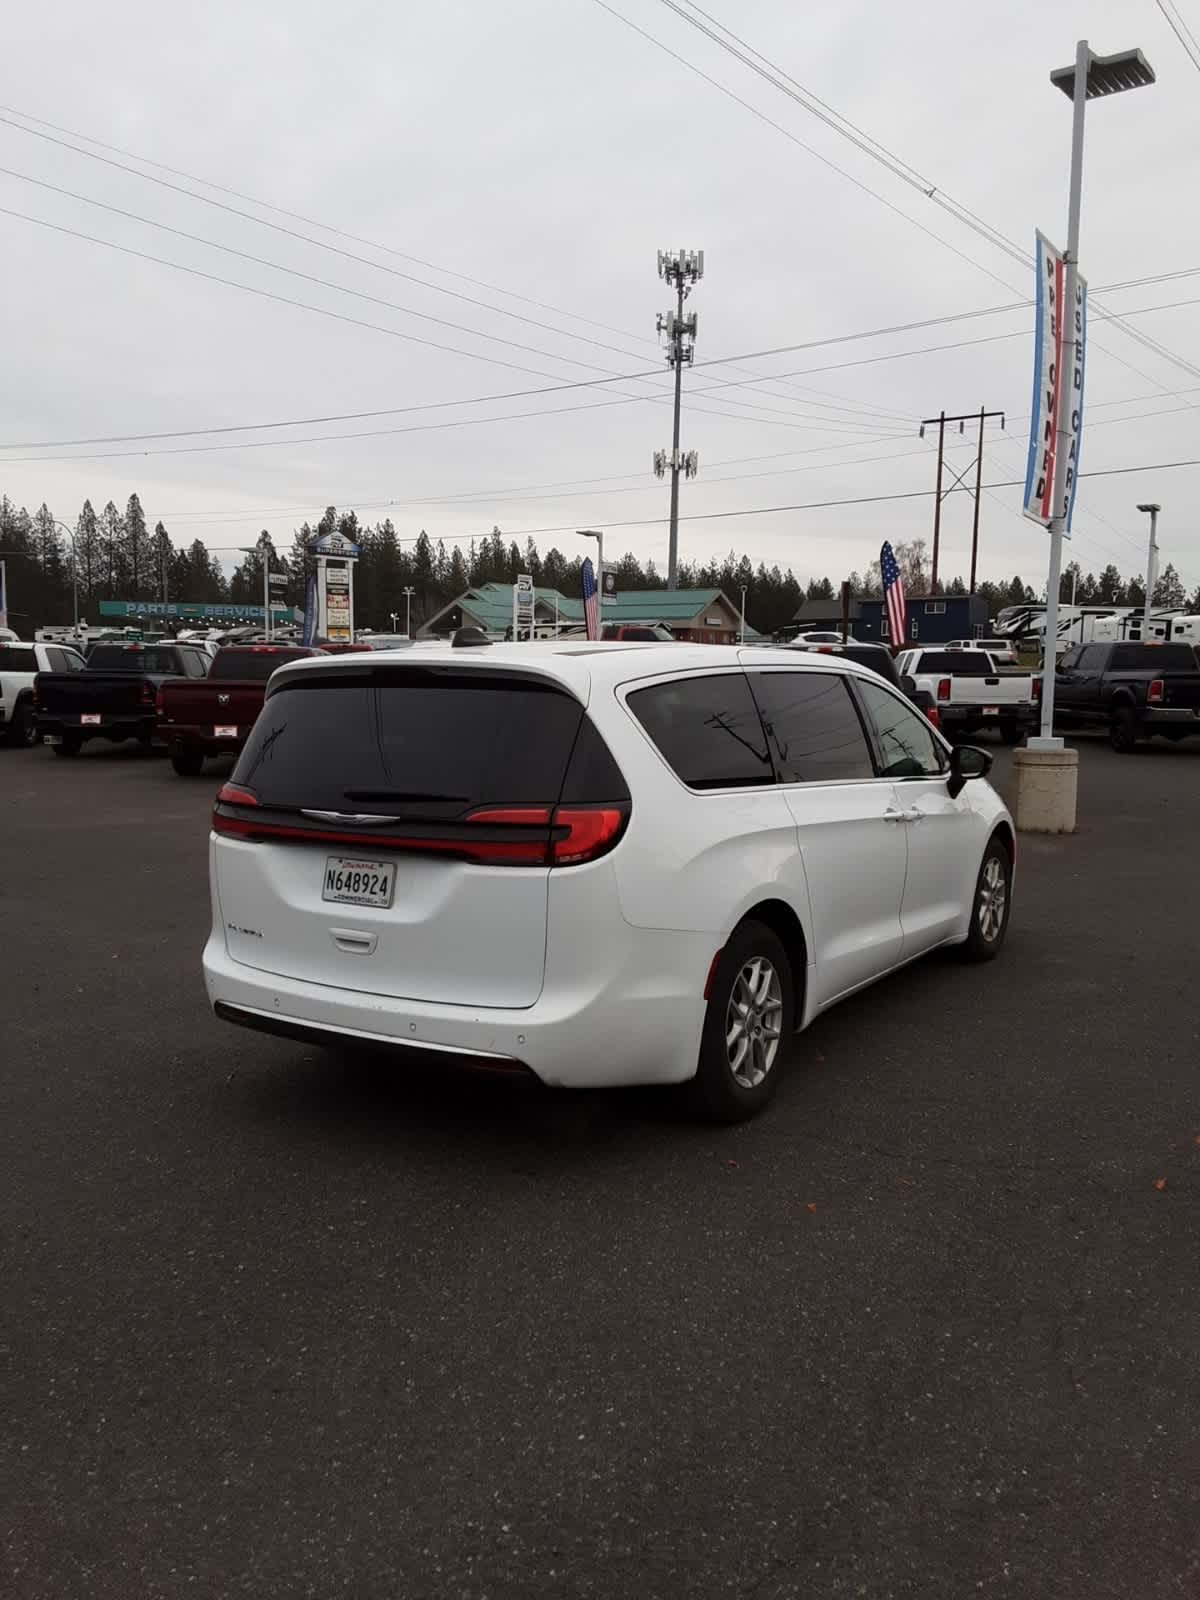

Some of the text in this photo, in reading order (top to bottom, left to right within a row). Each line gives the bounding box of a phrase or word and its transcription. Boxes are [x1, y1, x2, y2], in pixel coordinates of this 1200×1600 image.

[1063, 285, 1082, 518] USED CARS
[126, 603, 265, 617] PARTS SERVICE
[327, 870, 388, 896] N648924
